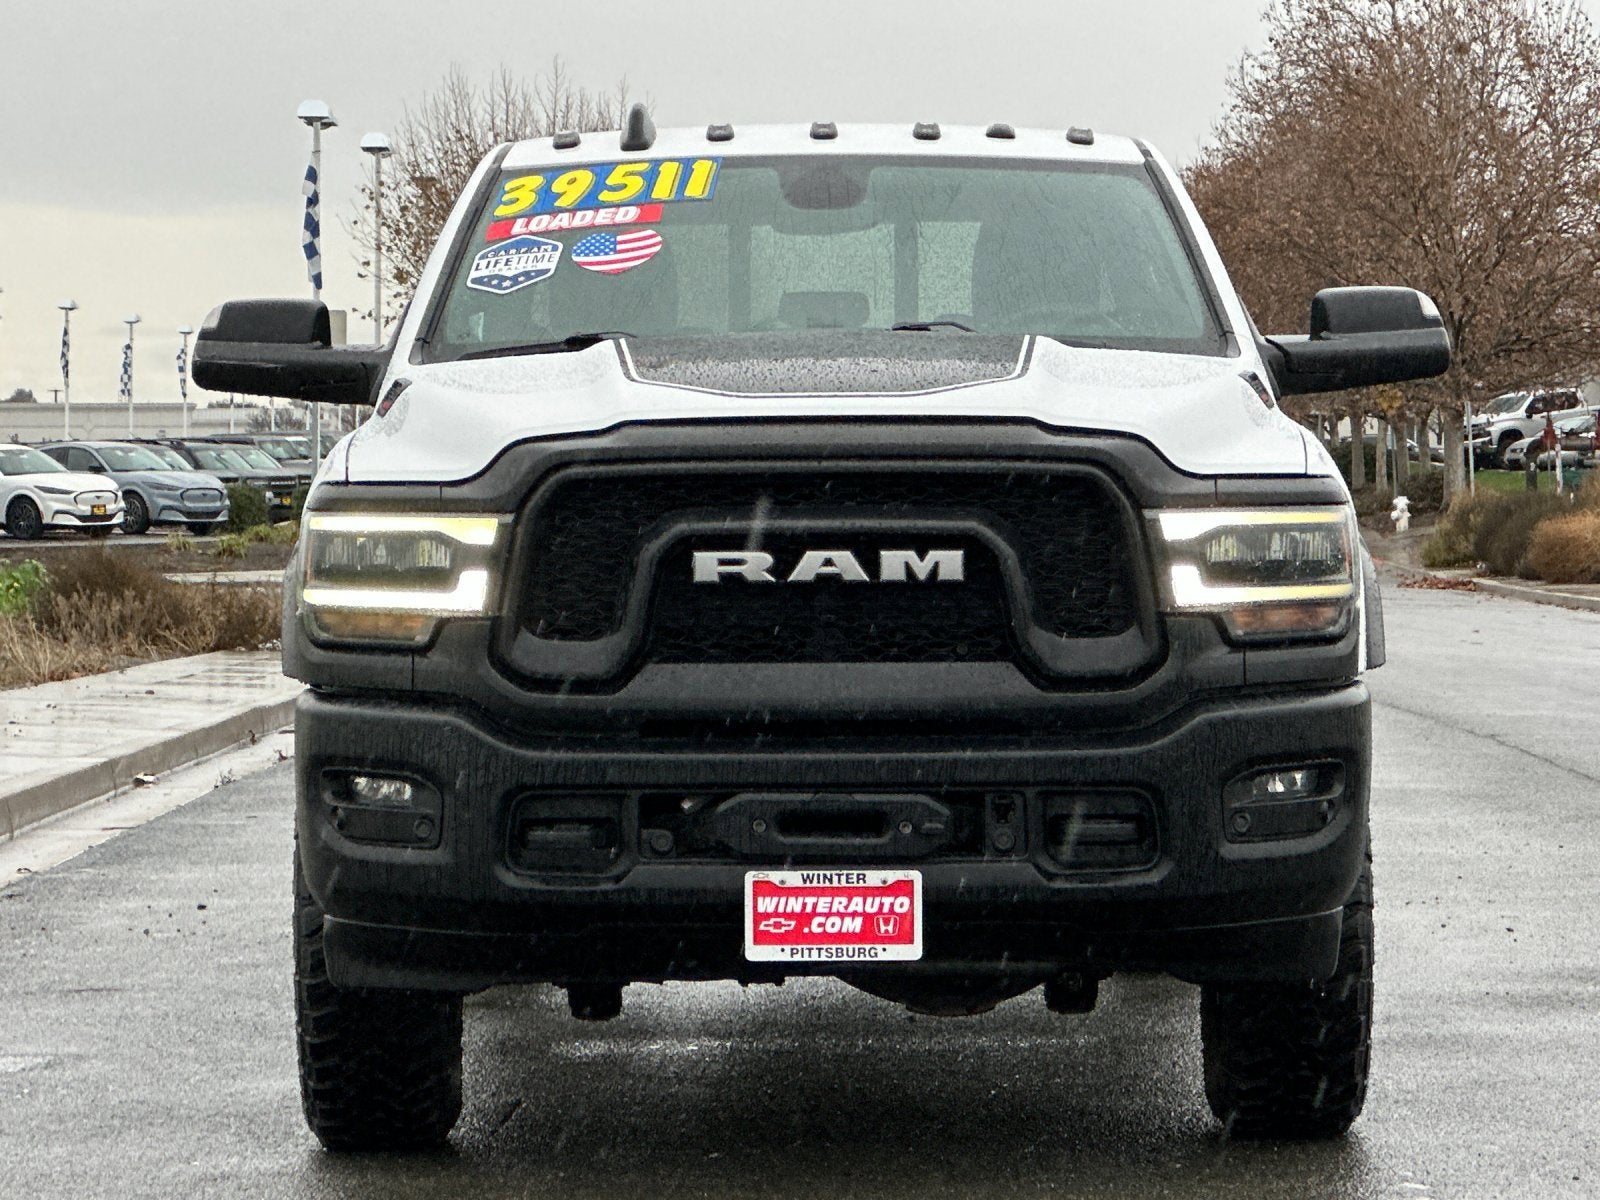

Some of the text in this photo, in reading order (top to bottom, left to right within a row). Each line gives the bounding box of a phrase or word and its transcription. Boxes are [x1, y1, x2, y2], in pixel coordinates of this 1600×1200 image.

[494, 159, 717, 217] 39511
[510, 206, 642, 234] LOADED
[487, 245, 553, 258] CARFAX
[474, 253, 556, 271] LIFETIME
[693, 550, 964, 582] RAM
[801, 873, 867, 885] WINTER
[757, 897, 911, 913] WINTERAUTO
[803, 916, 863, 933] .COM
[790, 947, 878, 959] PITTSBURG
